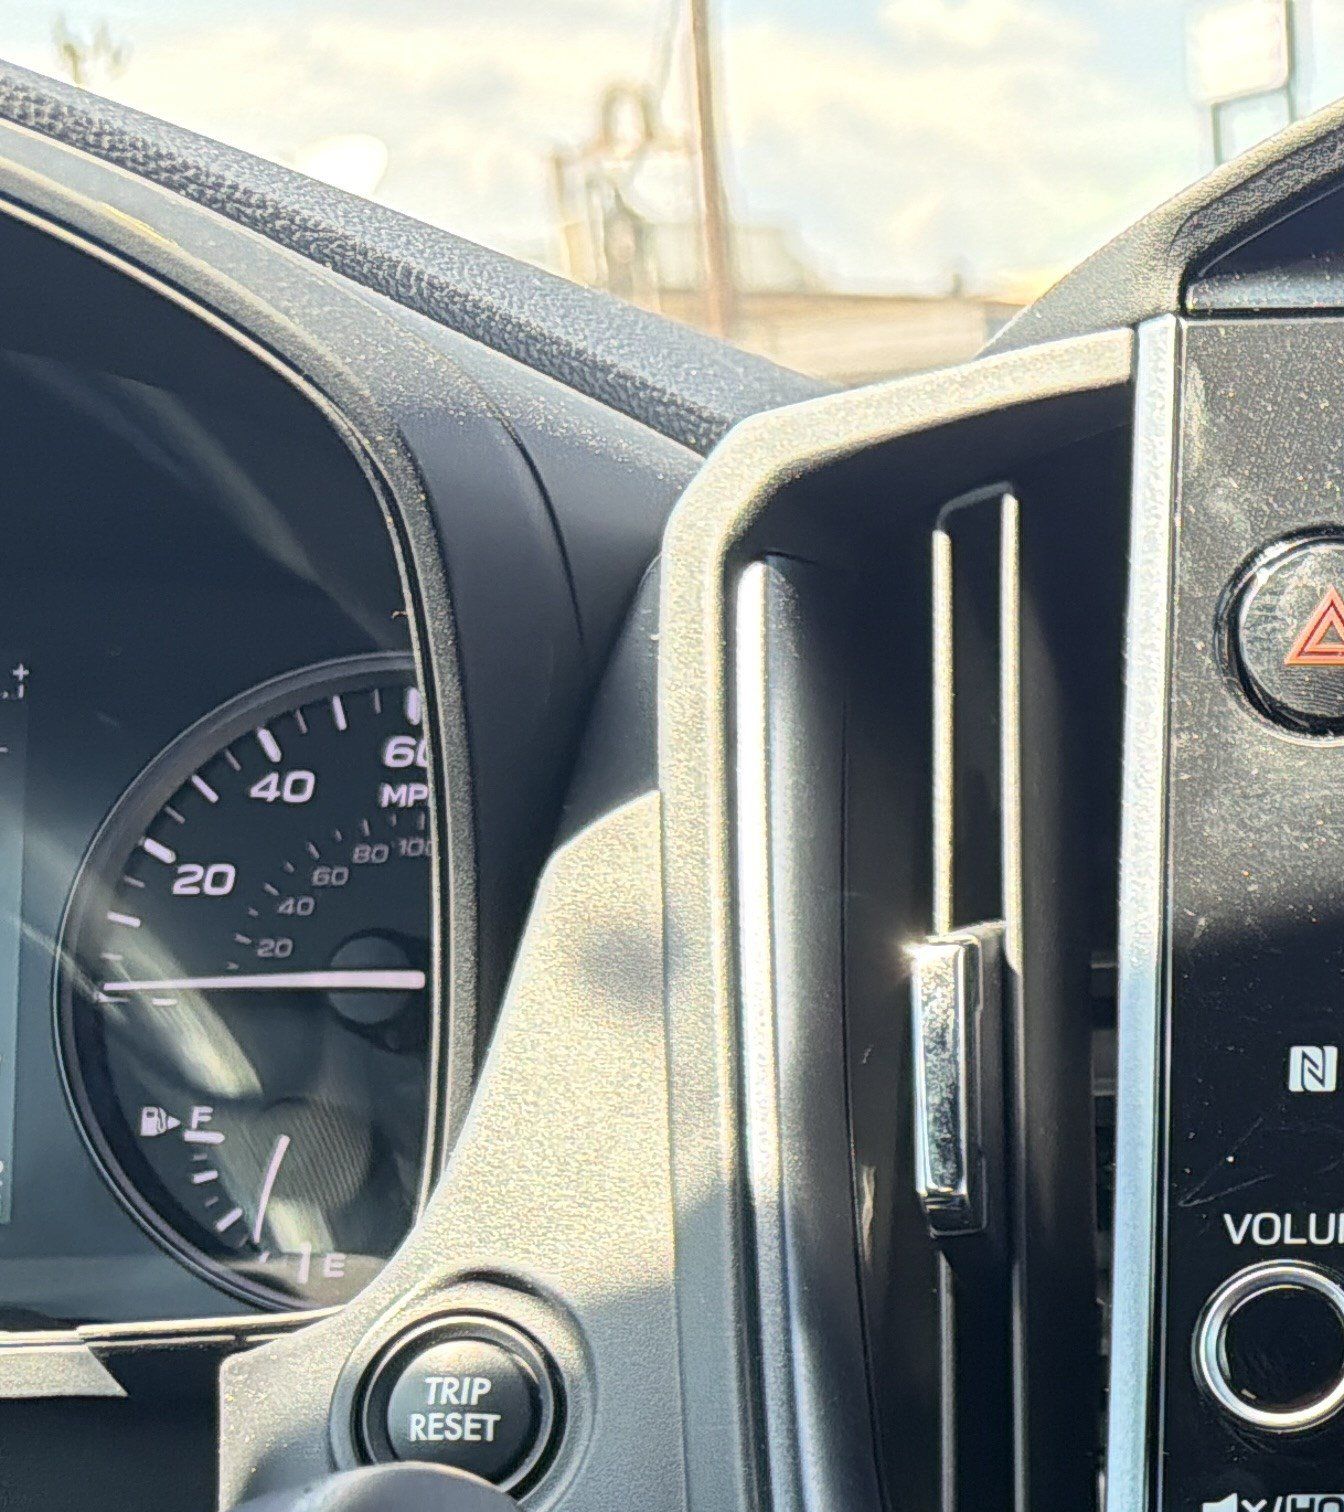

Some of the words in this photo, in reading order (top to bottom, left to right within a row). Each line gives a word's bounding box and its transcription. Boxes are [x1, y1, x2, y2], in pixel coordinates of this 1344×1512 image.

[249, 770, 316, 803] 40
[380, 783, 430, 808] MP
[352, 843, 390, 864] 80
[172, 863, 236, 896] 20
[310, 865, 350, 887] 60
[276, 896, 315, 916] 40
[256, 936, 293, 959] 20
[190, 1106, 214, 1131] F
[323, 1252, 346, 1279] E
[424, 1377, 492, 1406] TRIP
[409, 1412, 501, 1442] RESET
